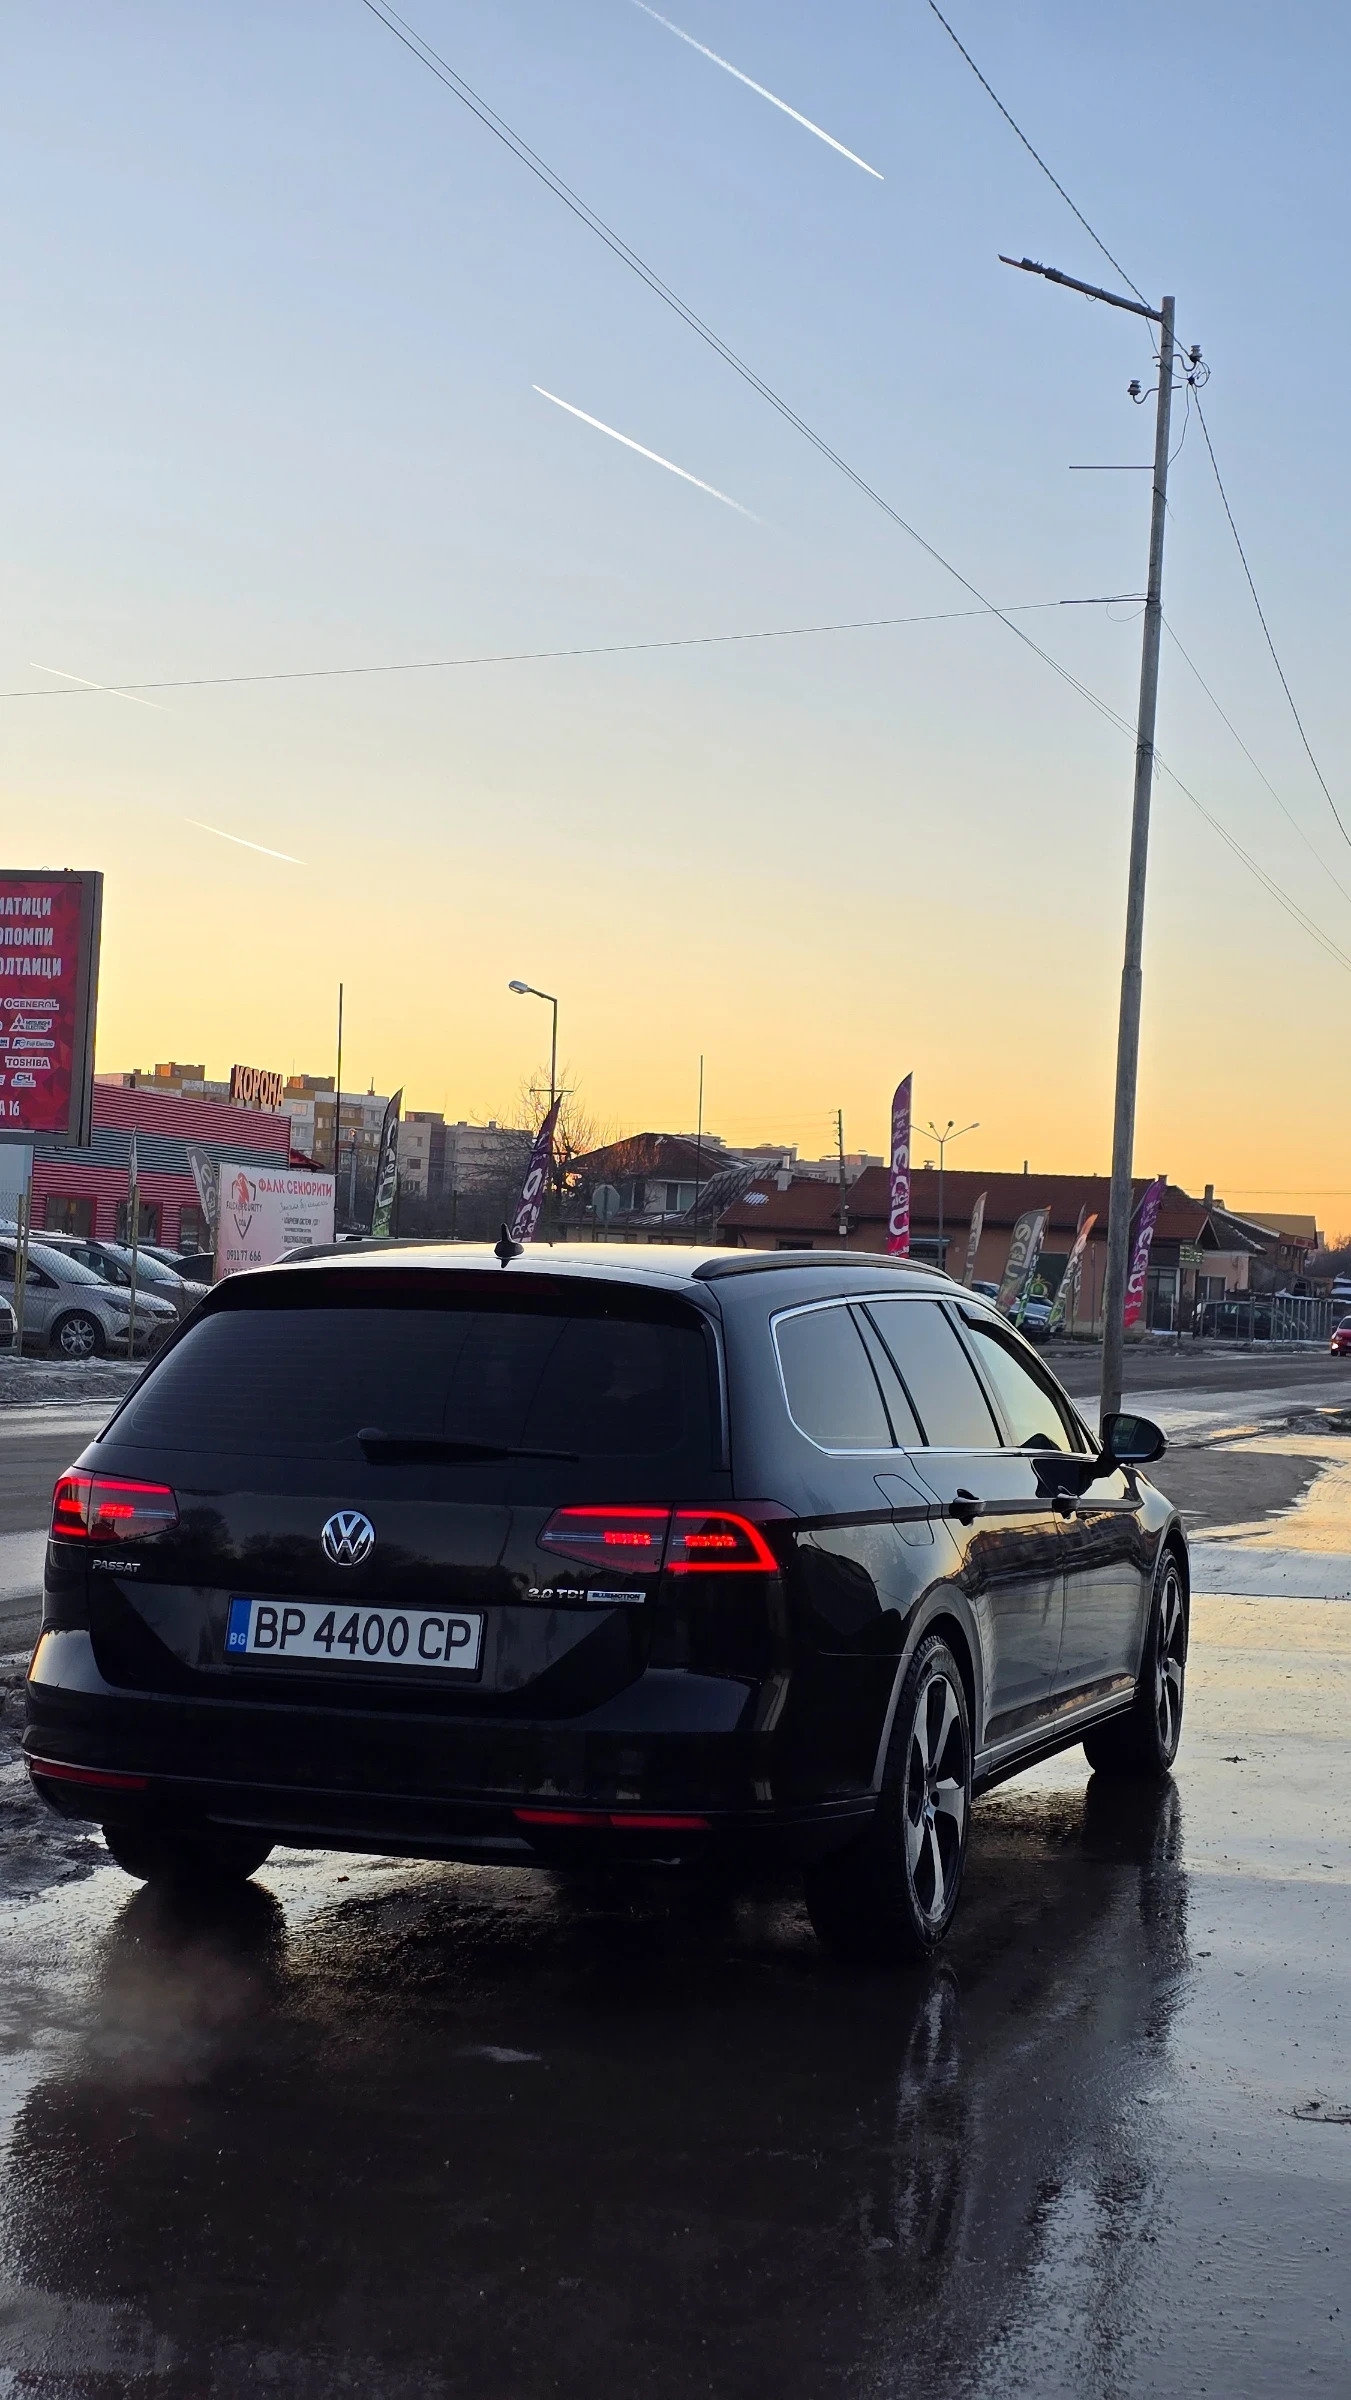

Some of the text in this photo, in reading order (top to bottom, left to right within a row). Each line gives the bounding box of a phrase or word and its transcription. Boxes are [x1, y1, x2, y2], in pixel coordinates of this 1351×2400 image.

[6, 1058, 49, 1068] TOSHIBA
[231, 1064, 284, 1107] КОРОНА
[9, 1100, 20, 1116] 16
[258, 1178, 333, 1198] ФАЛК СЕКЮРИТИ
[92, 1559, 141, 1573] PASSAT
[556, 1588, 585, 1599] TDI
[229, 1632, 246, 1646] BG
[253, 1606, 472, 1661] BP 4400 CP
